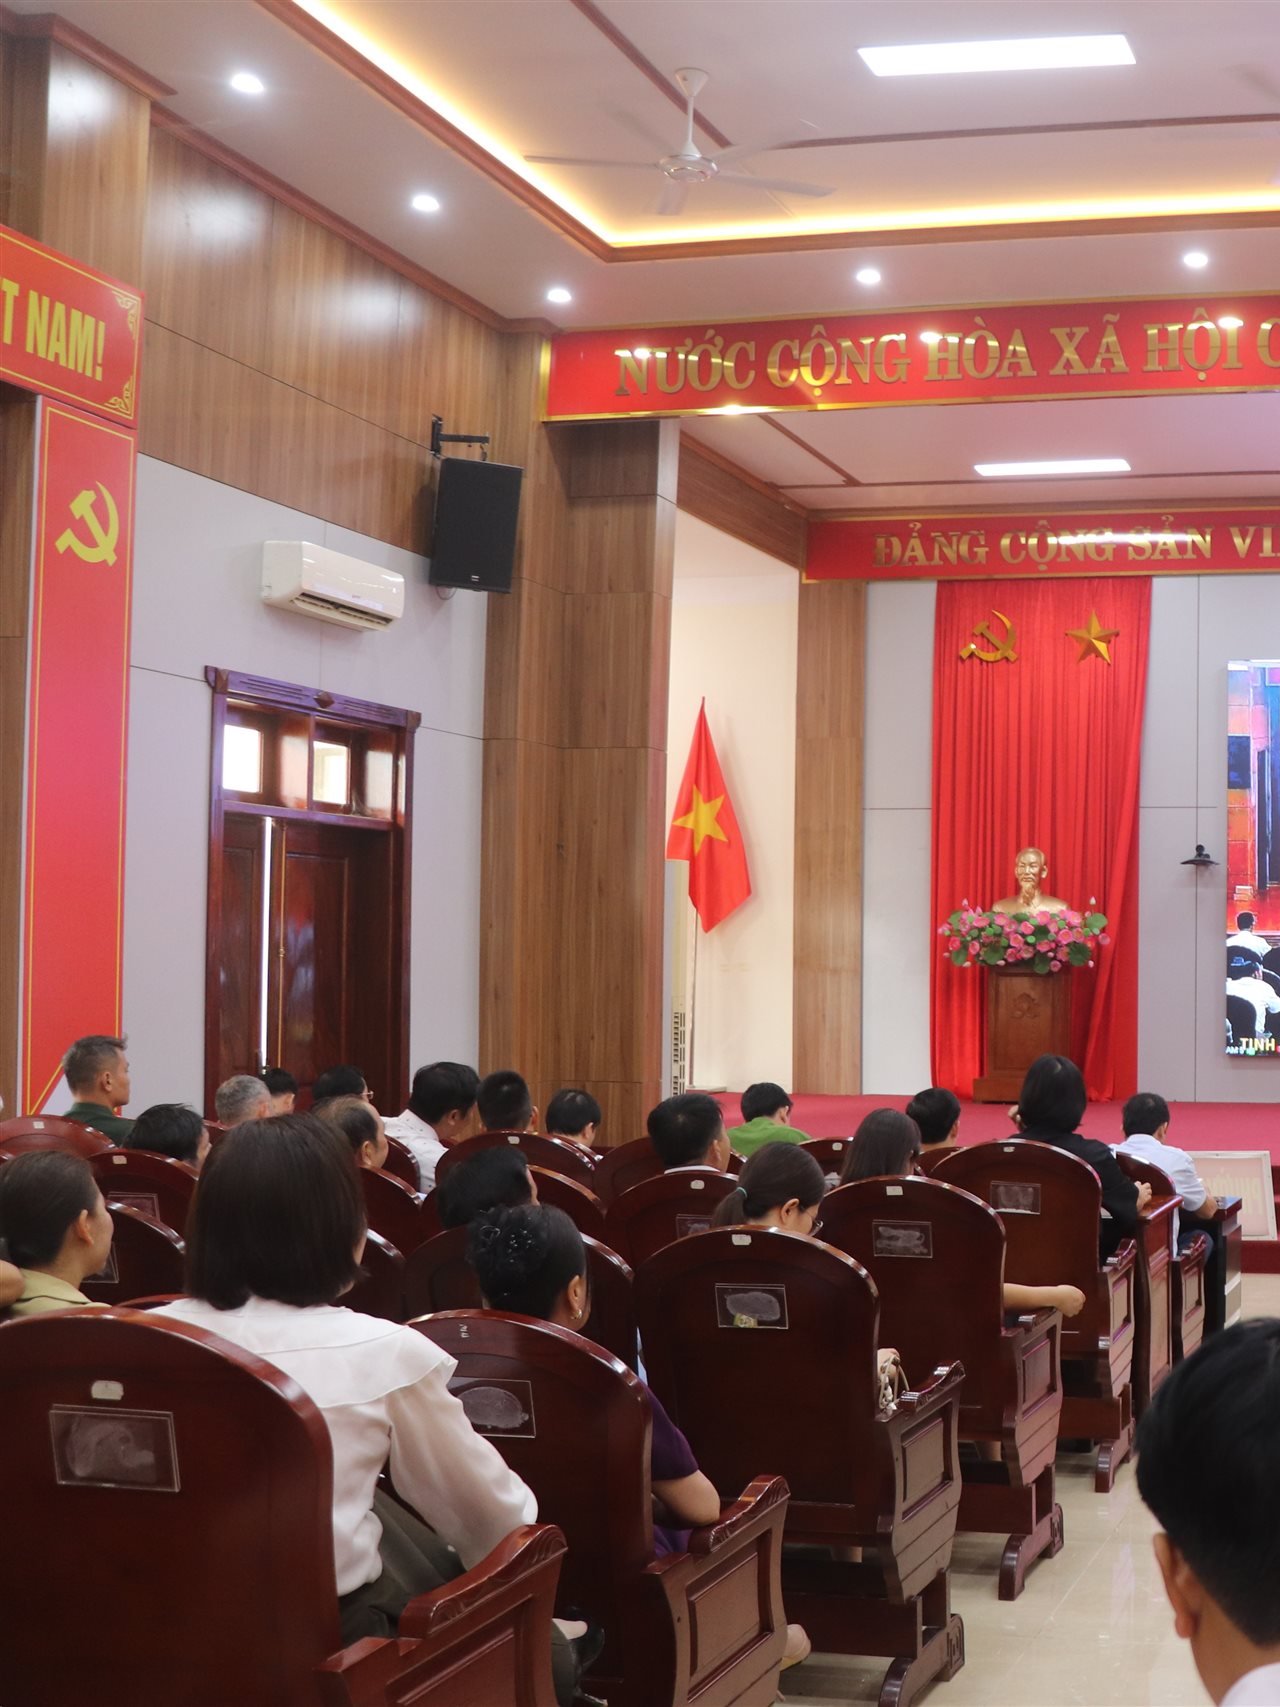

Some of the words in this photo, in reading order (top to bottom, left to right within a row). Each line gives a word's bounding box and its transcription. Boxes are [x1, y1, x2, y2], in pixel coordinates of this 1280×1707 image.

[0, 277, 19, 345] T
[26, 289, 105, 381] NAM!
[615, 328, 756, 396] NƯỚC
[766, 324, 911, 396] CỘNG
[922, 316, 1037, 381] HÒA
[1049, 313, 1129, 375] XÃ
[1142, 307, 1243, 381] HỘI
[873, 521, 989, 568] ĐẢNG
[1000, 519, 1116, 572] CỘNG
[1128, 514, 1214, 561] SẢN
